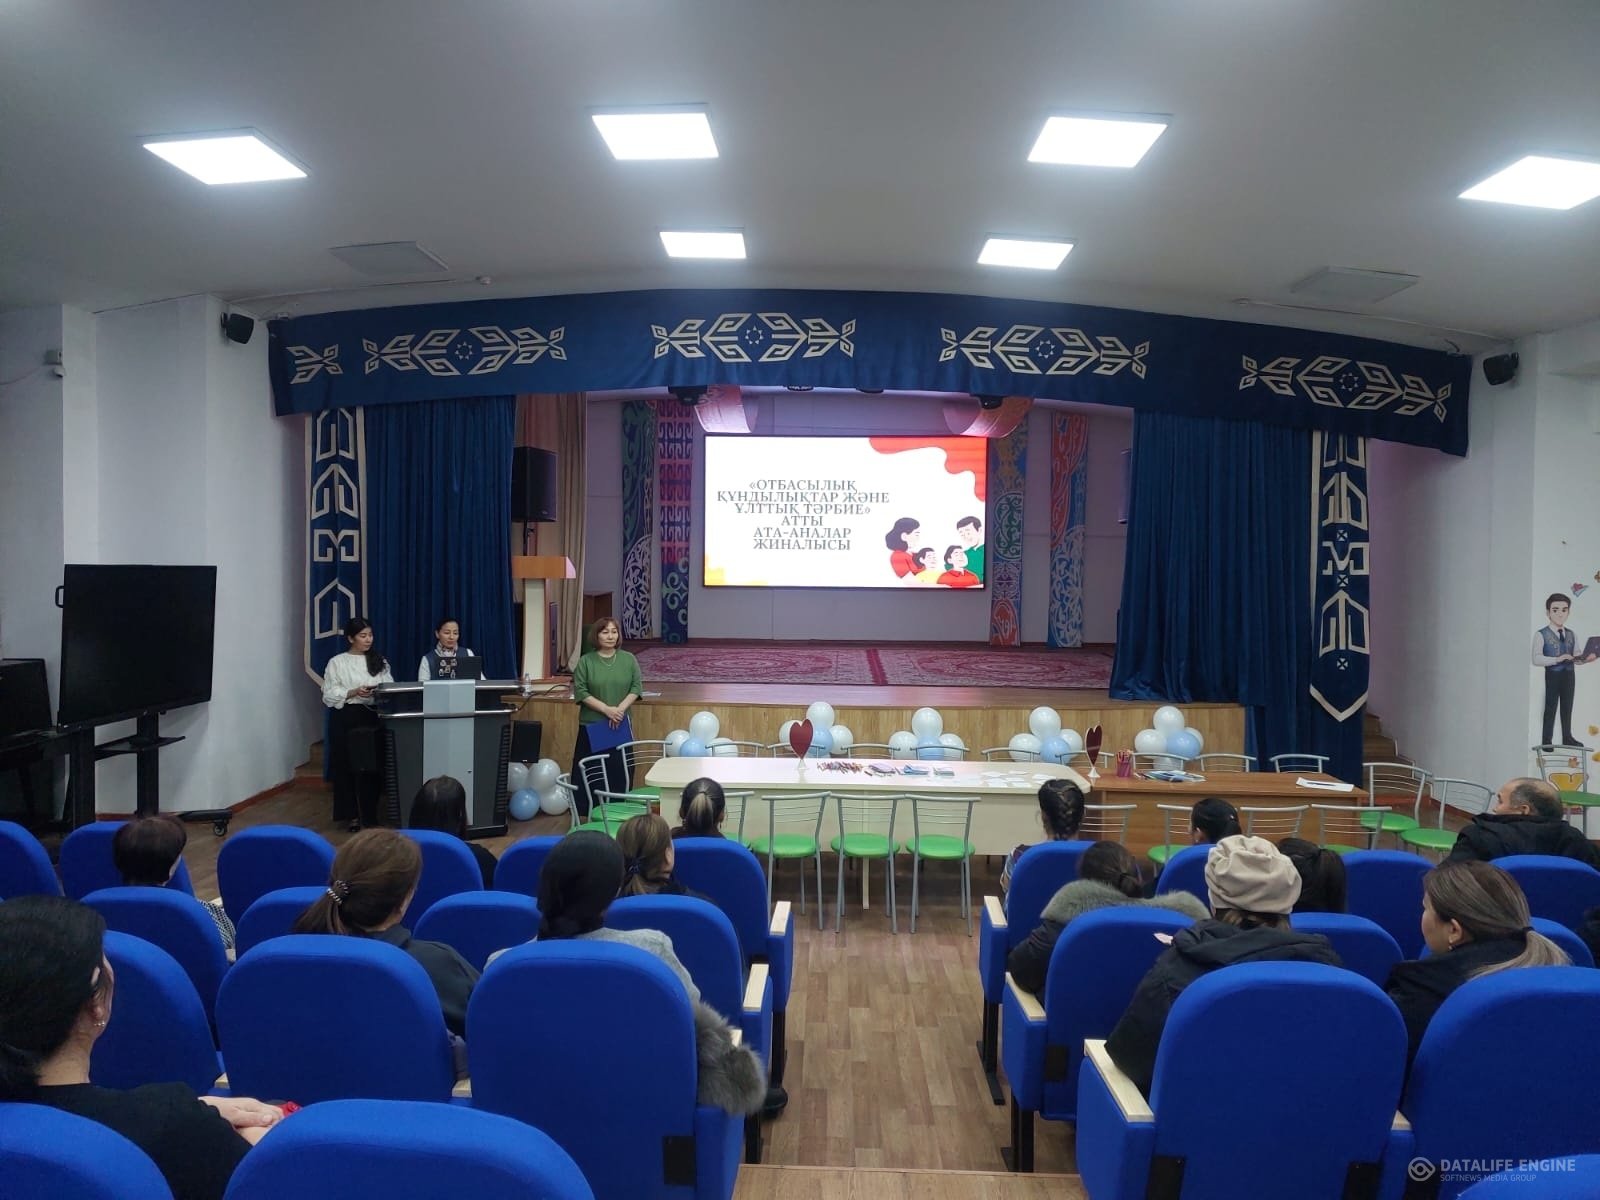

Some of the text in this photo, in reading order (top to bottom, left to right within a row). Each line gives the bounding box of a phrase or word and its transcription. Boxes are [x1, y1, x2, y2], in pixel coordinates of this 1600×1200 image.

[842, 492, 890, 503] ЖӘНЕ
[781, 515, 823, 526] АТТЫ
[753, 527, 851, 538] АТА-АНАЛАР
[753, 538, 850, 550] ЖИНАЛЫСЫ
